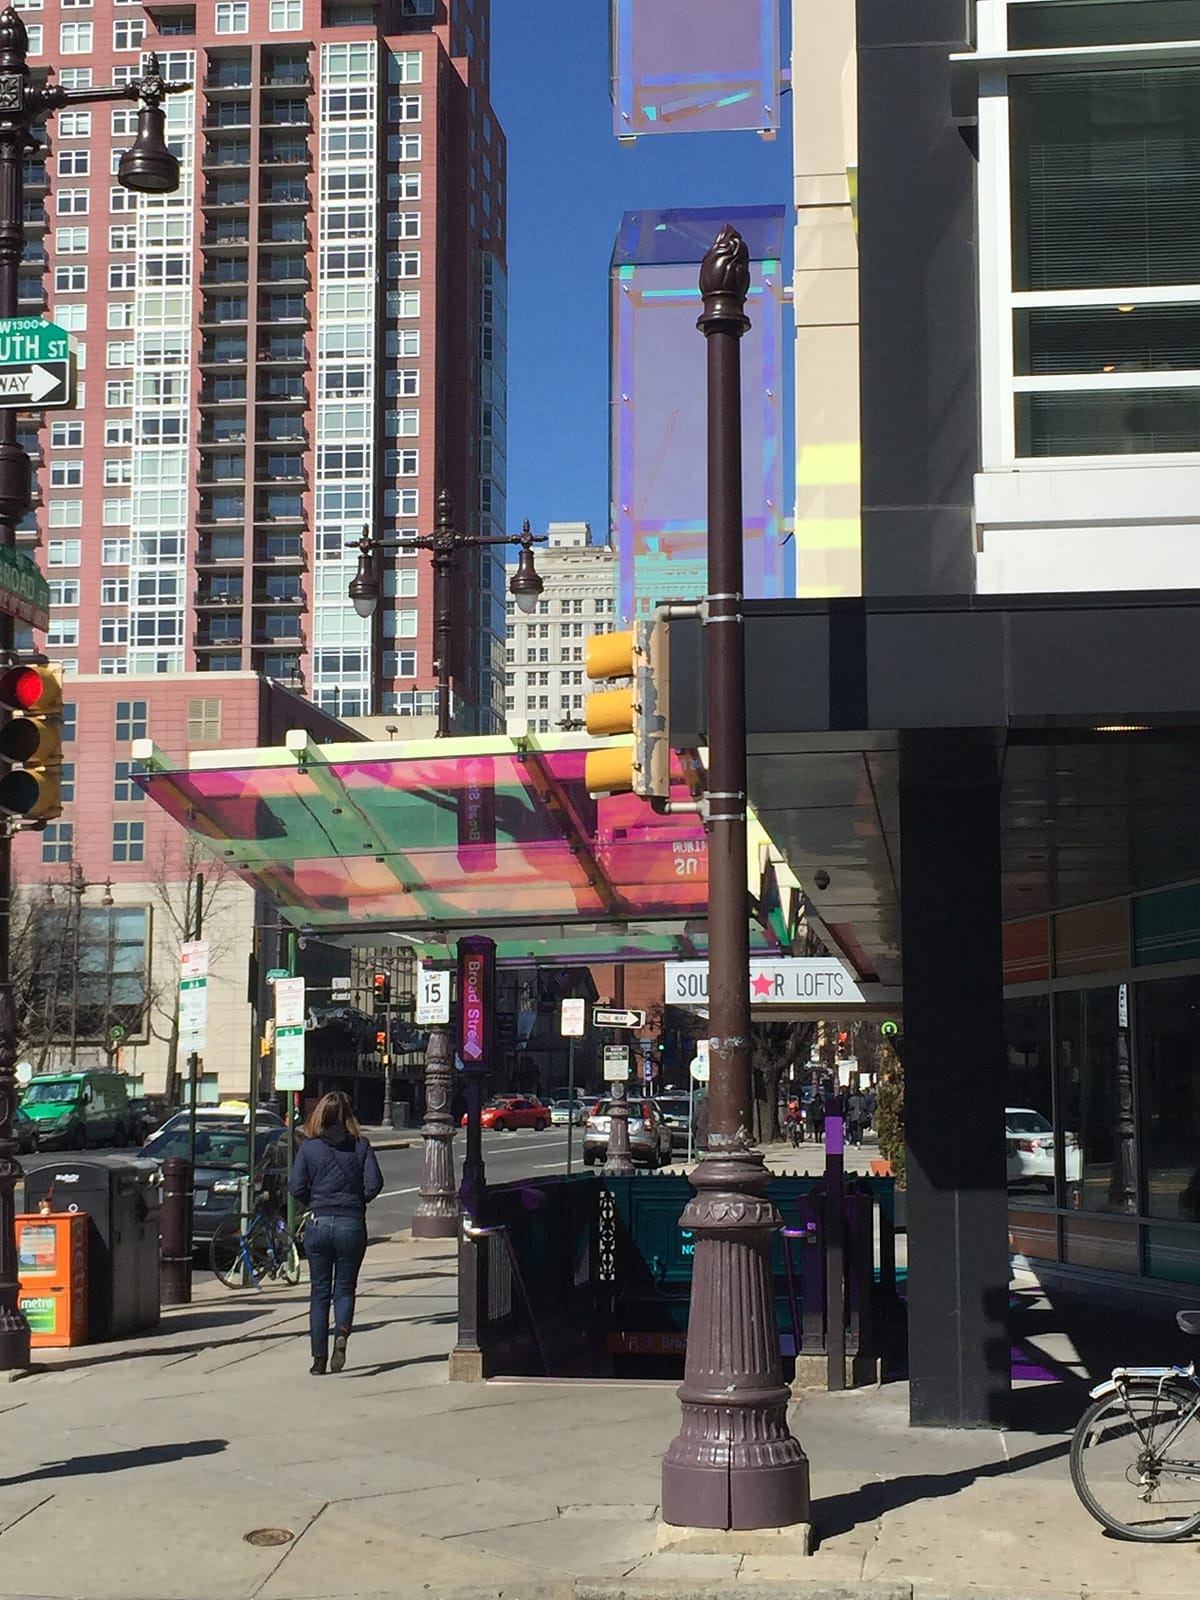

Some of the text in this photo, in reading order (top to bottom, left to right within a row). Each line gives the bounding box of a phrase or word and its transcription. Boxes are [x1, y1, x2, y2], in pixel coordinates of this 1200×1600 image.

[47, 340, 67, 358] ST
[468, 960, 480, 1003] Broad
[796, 972, 844, 997] LOFTS
[425, 983, 442, 1003] 15
[21, 1298, 54, 1310] metro
